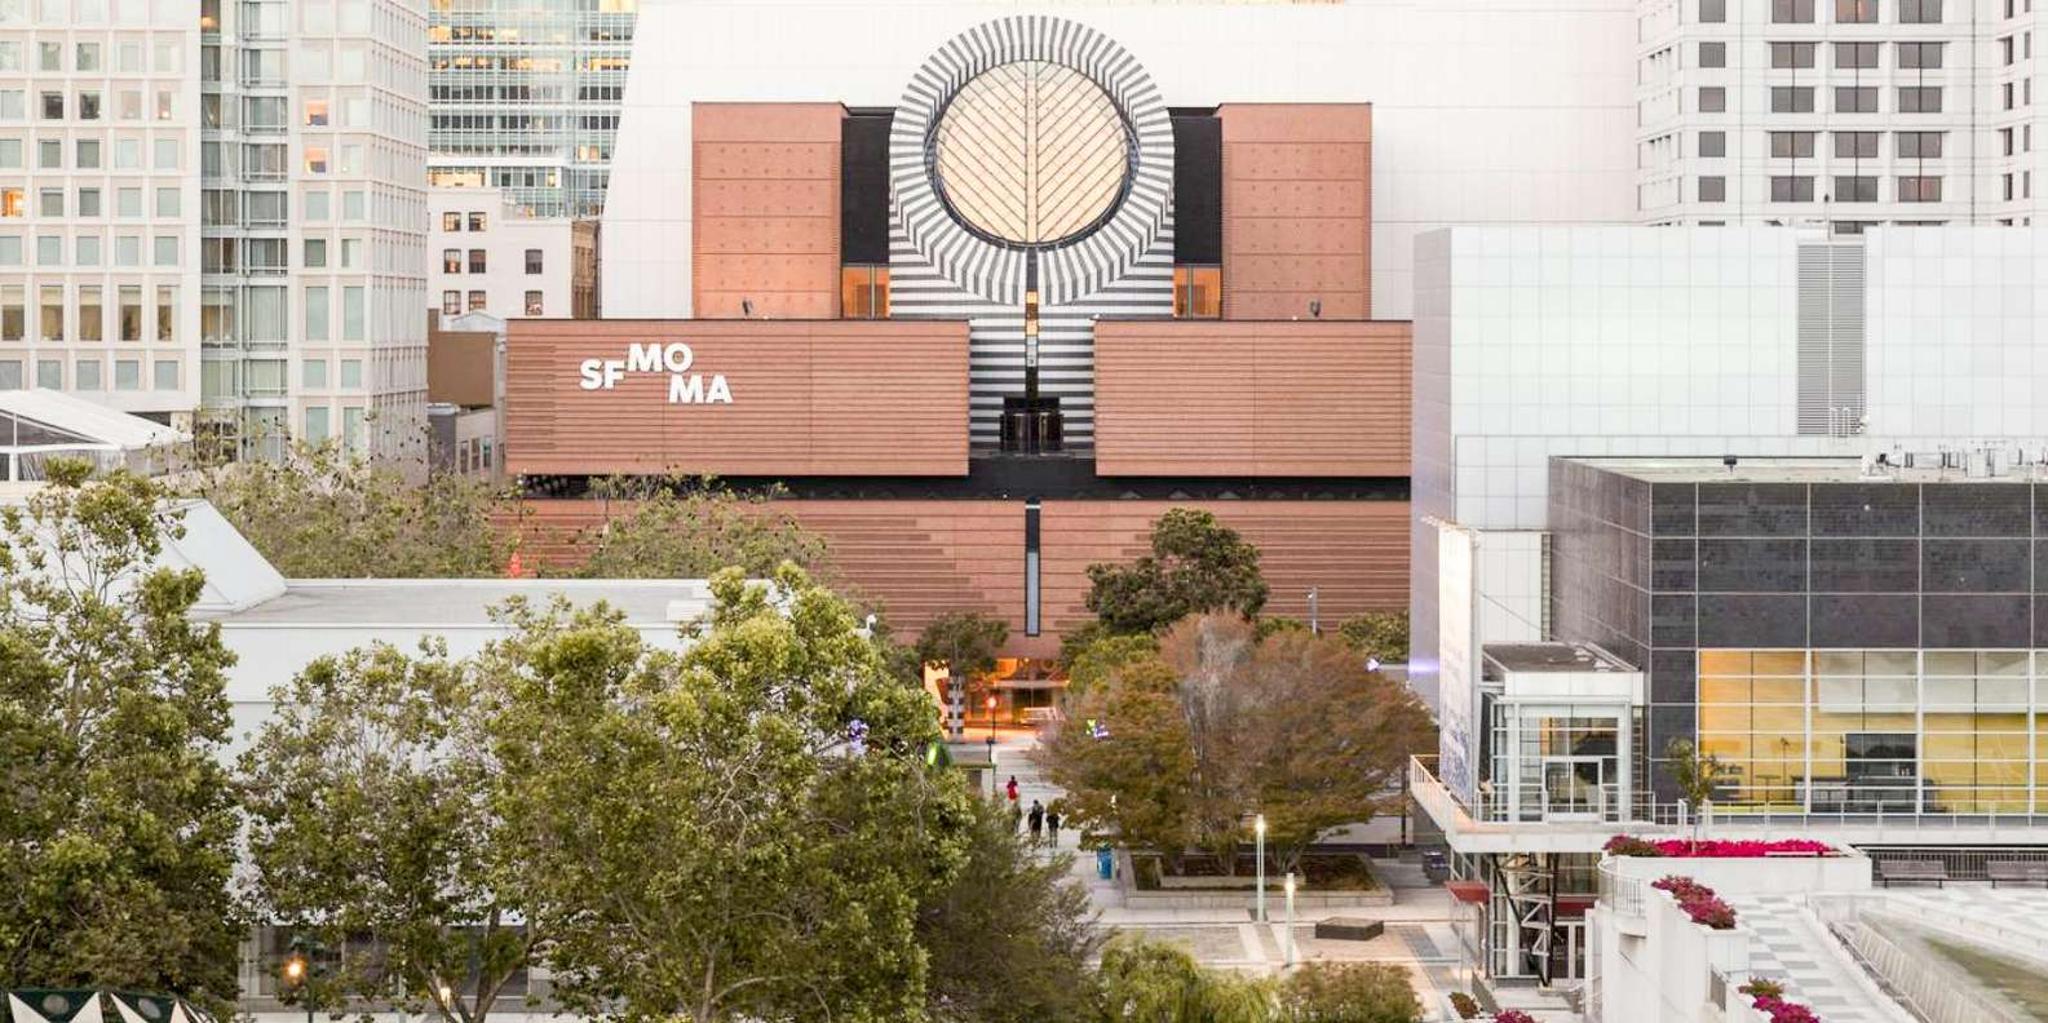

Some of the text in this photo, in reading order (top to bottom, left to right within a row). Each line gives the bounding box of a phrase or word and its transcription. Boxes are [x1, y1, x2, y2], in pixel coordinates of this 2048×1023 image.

[627, 342, 693, 373] MO
[579, 358, 625, 390] SF
[669, 373, 733, 404] MA
